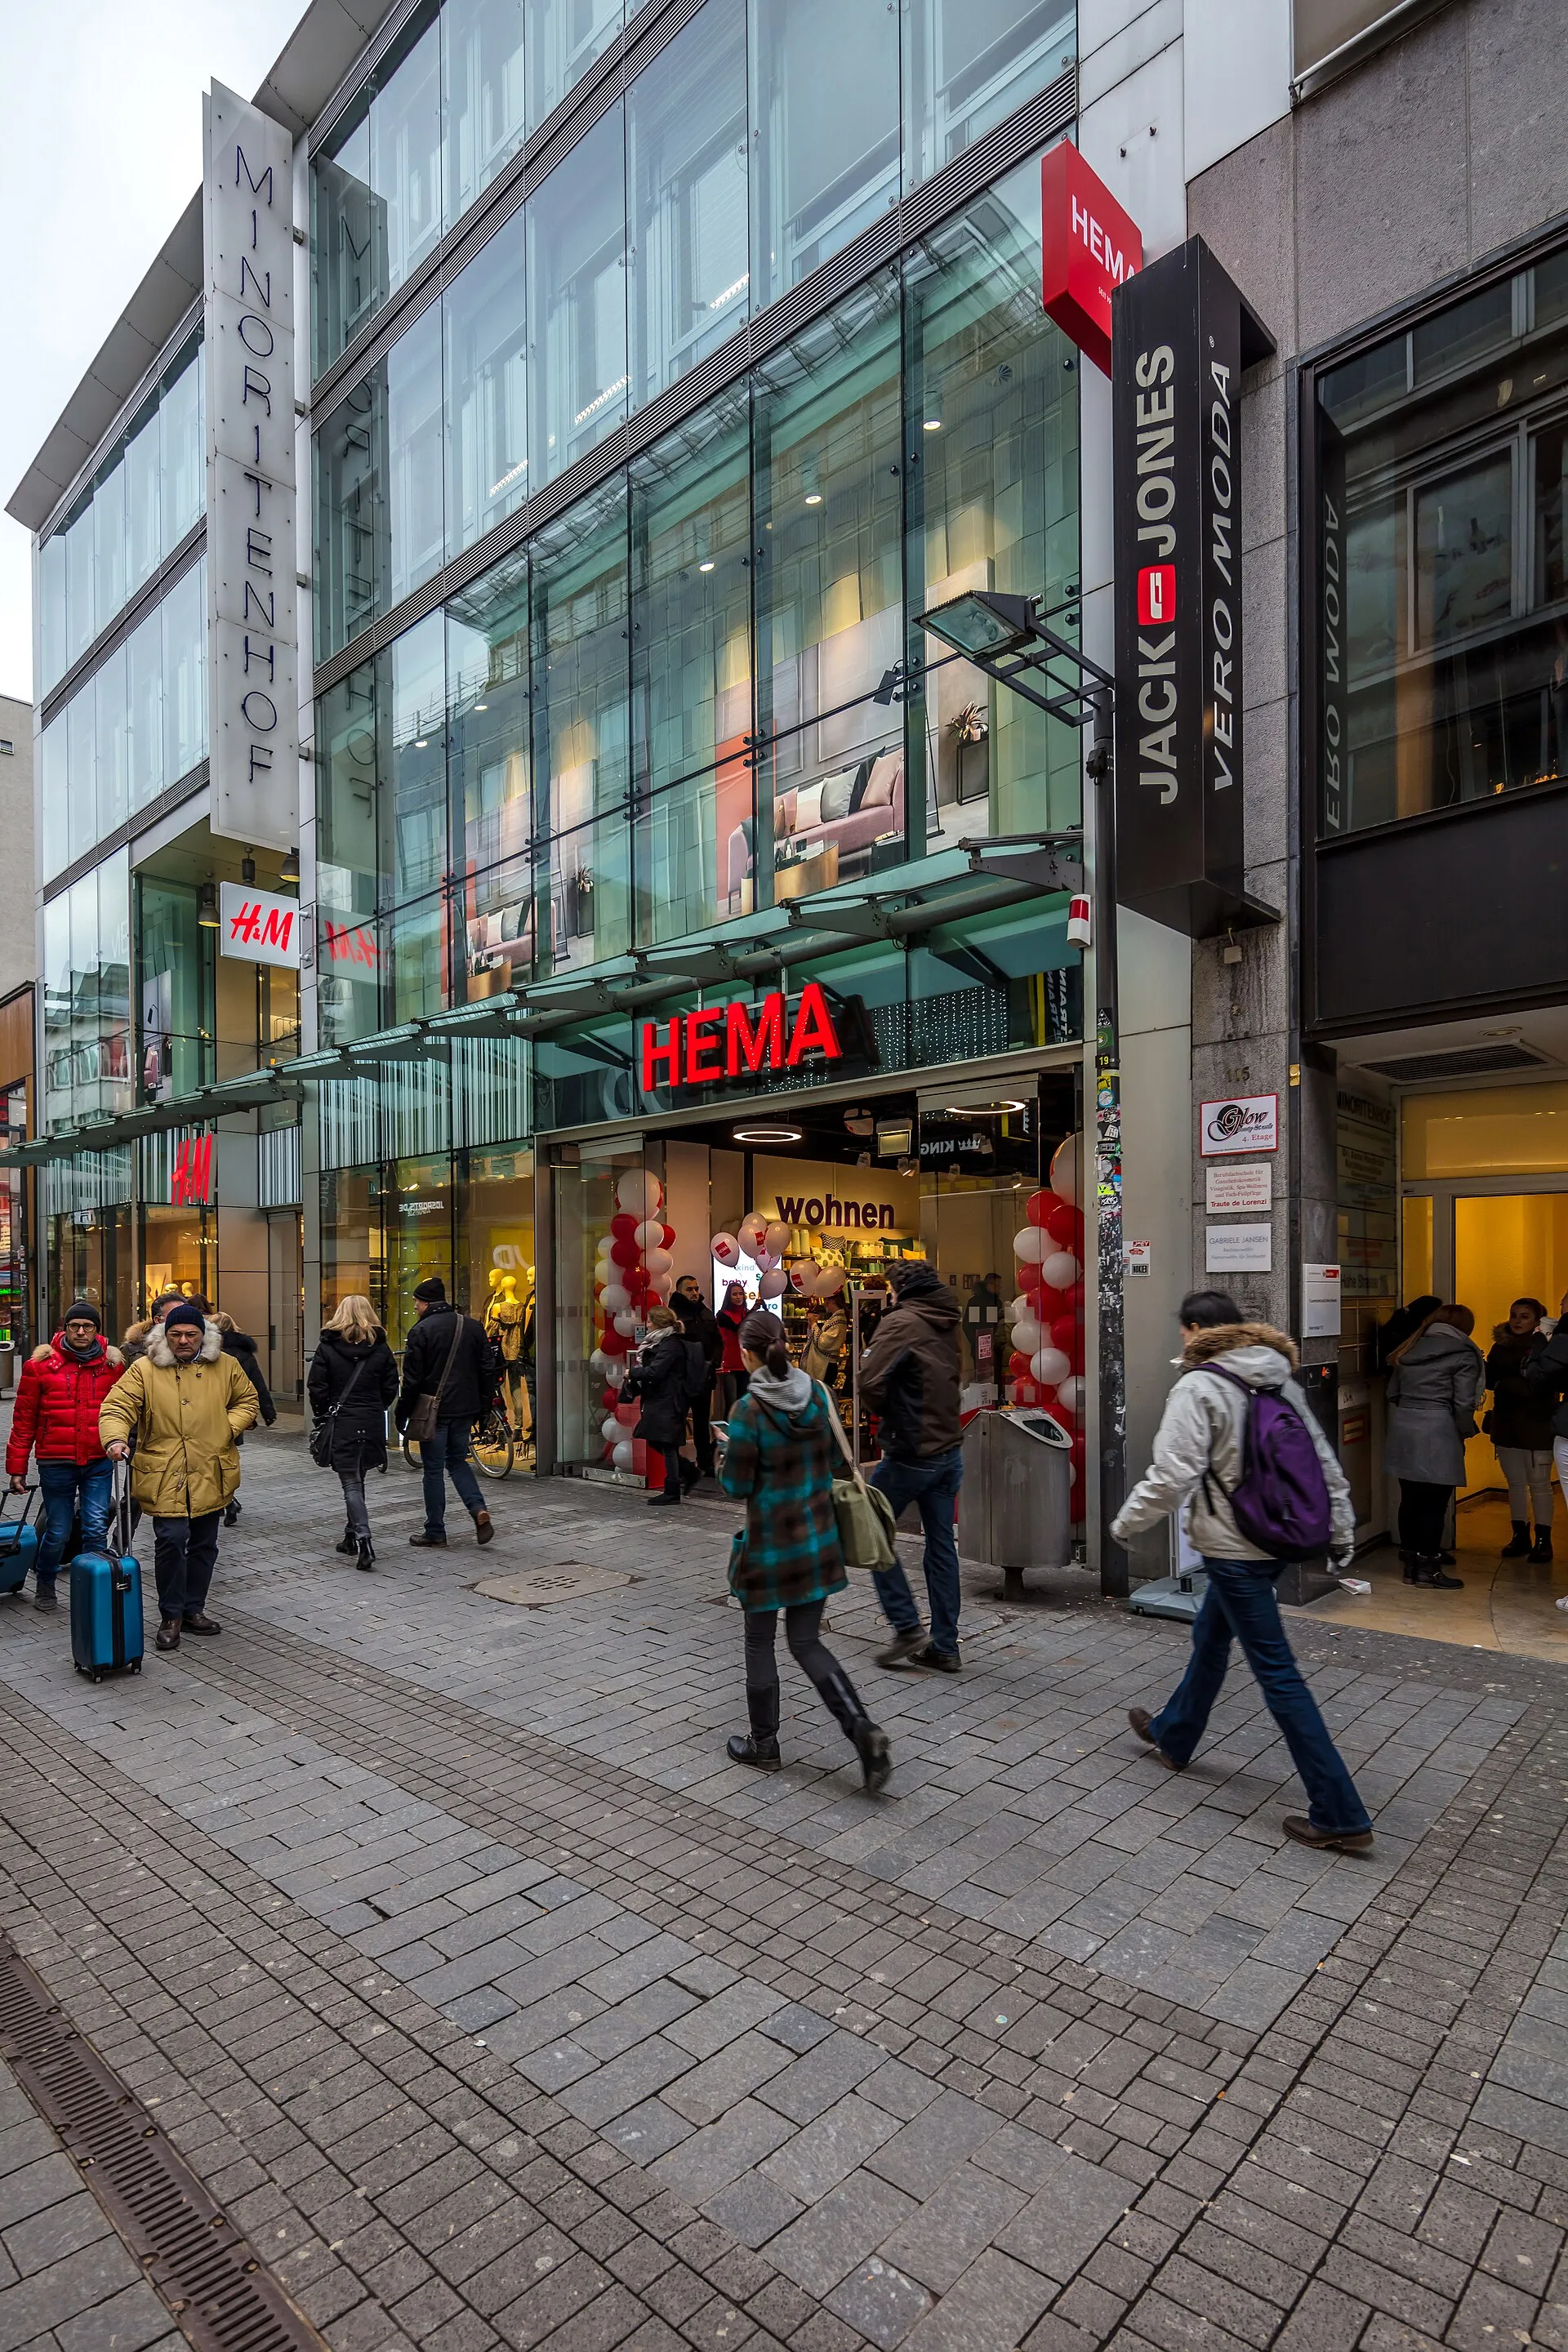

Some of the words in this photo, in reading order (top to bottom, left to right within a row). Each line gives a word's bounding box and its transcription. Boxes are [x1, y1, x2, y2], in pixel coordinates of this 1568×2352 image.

[235, 145, 278, 783] MINORITENHOF
[1135, 344, 1177, 558] JONES
[1209, 360, 1233, 586] MODA
[1138, 630, 1180, 804] JACK
[1212, 603, 1235, 791] VERO
[229, 901, 294, 952] H&M
[641, 982, 842, 1093] HEMA
[1098, 1056, 1109, 1066] 19
[1208, 1106, 1269, 1142] Glow
[171, 1133, 212, 1208] H&M
[1242, 1198, 1267, 1206] Lorenzi
[775, 1193, 895, 1231] wohnen
[1209, 1236, 1240, 1245] GABRIELE
